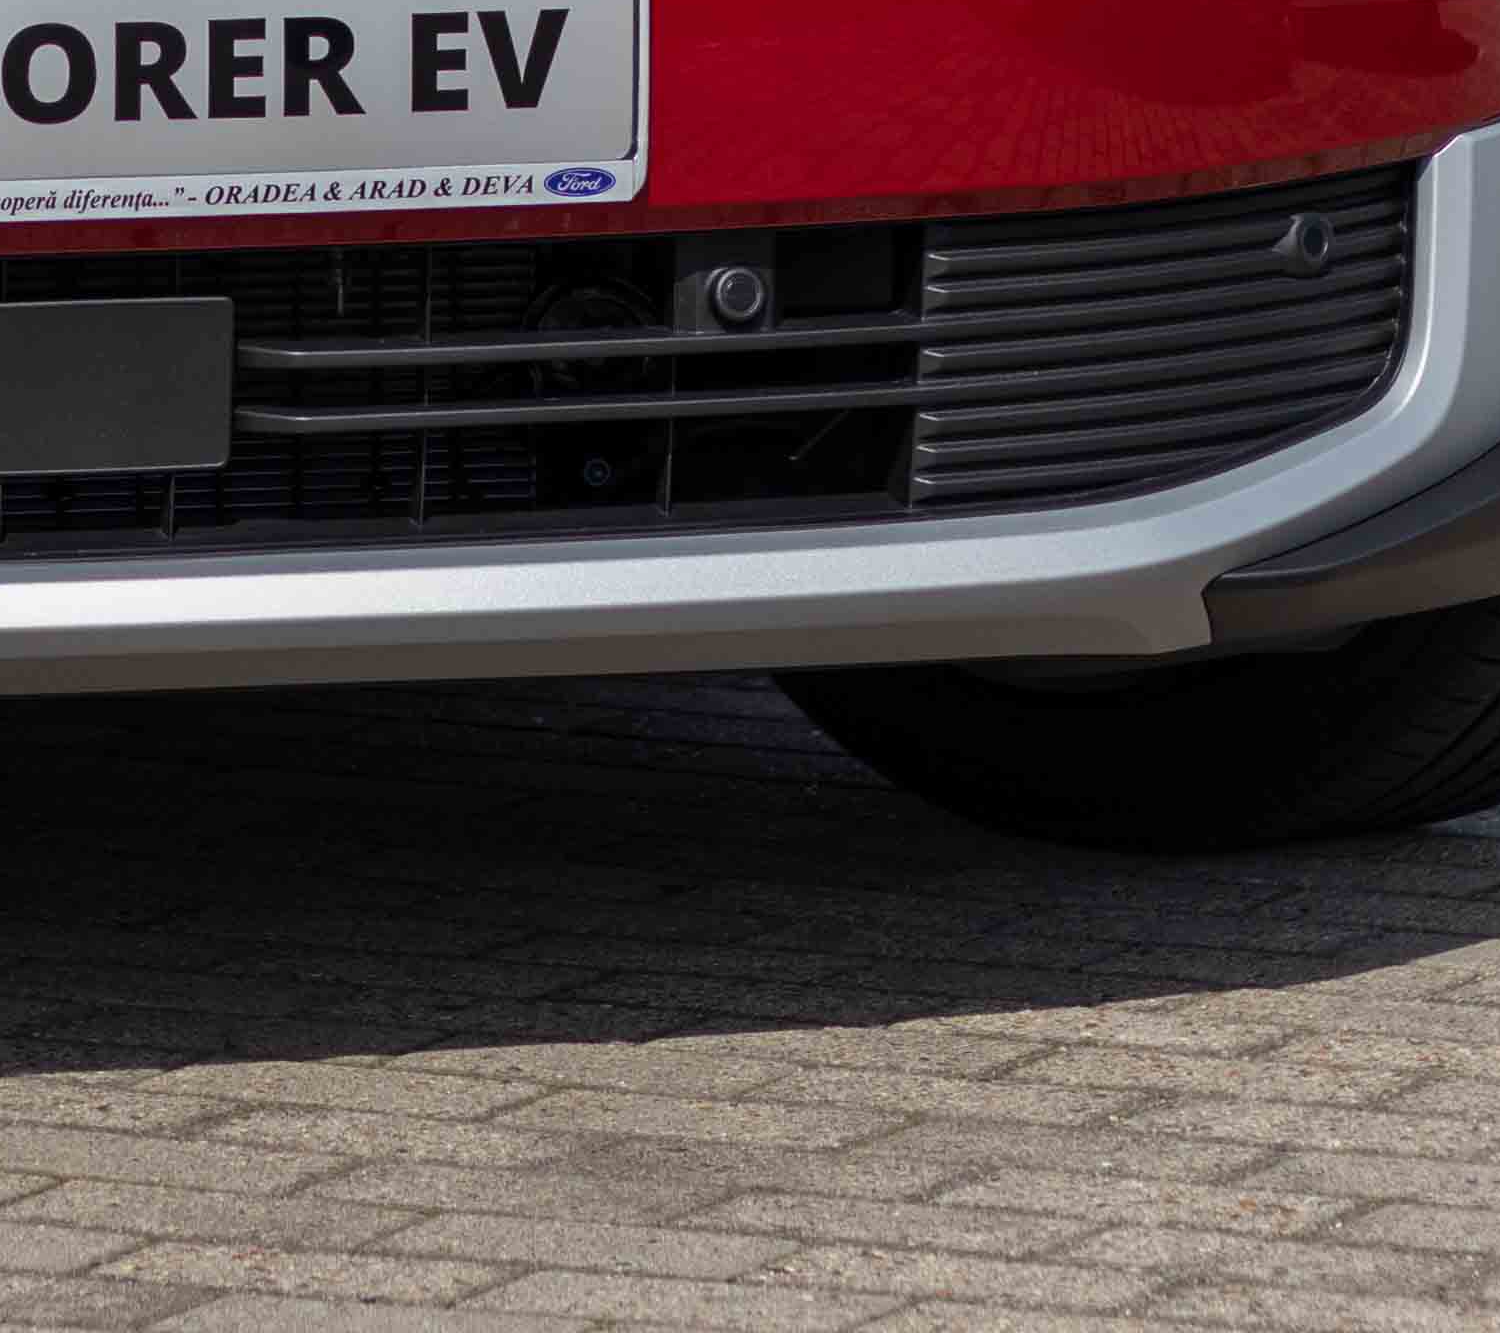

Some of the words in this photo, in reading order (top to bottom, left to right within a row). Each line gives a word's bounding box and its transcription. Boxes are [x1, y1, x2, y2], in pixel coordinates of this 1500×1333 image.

[410, 8, 572, 113] EV
[205, 182, 317, 205] ORADEA
[323, 180, 342, 200] &
[348, 177, 426, 200] ARAD
[434, 176, 452, 197] &
[460, 174, 535, 196] DEVA
